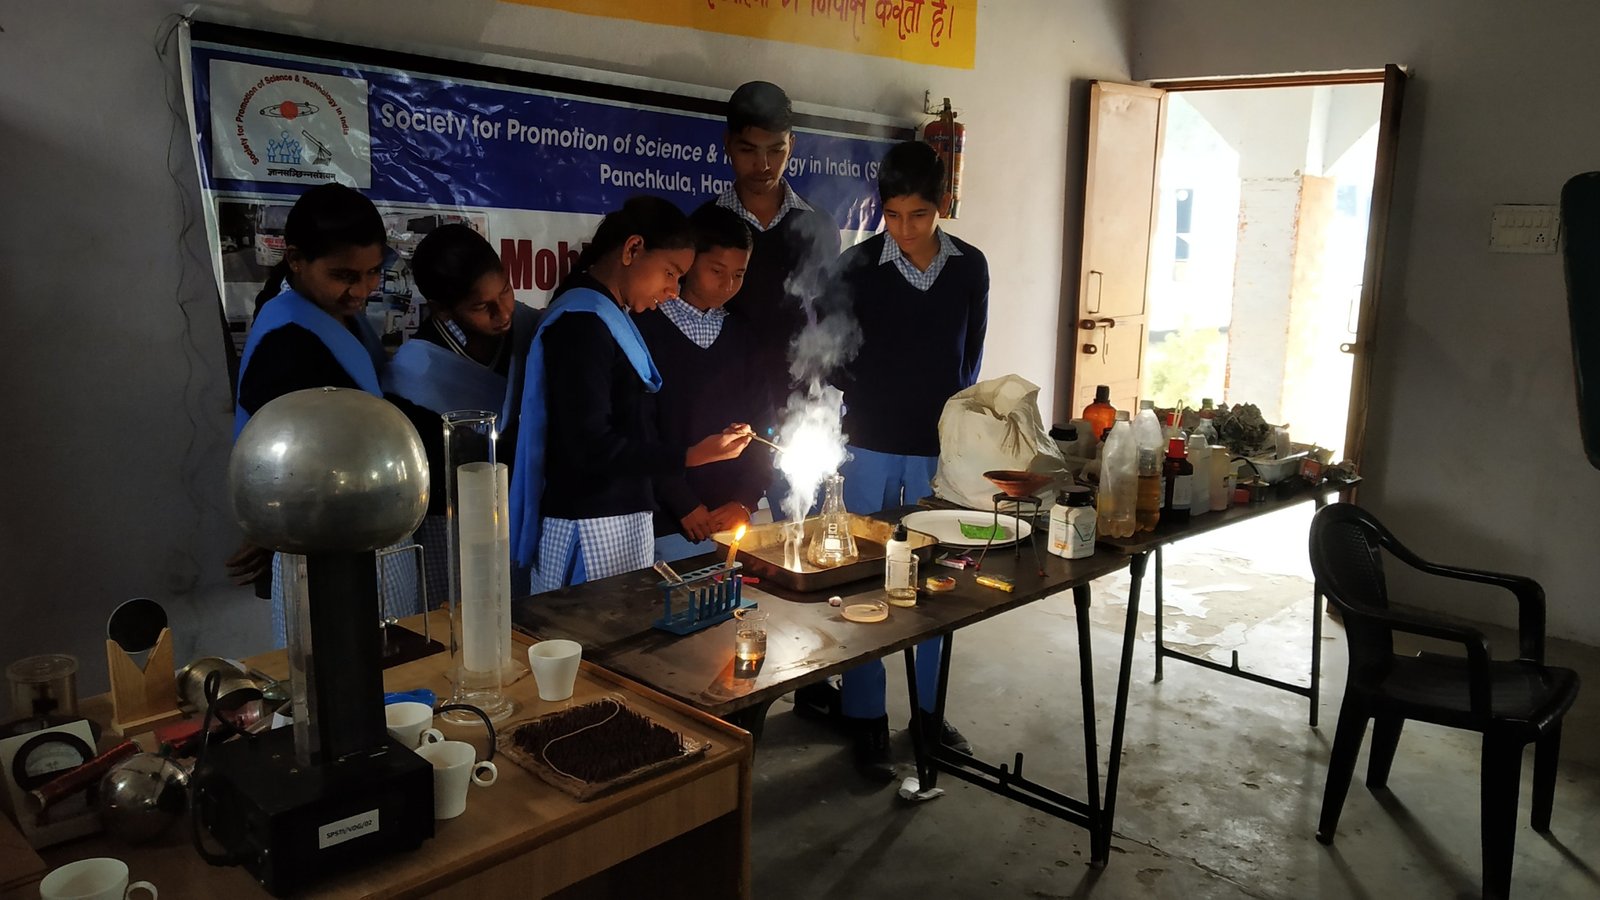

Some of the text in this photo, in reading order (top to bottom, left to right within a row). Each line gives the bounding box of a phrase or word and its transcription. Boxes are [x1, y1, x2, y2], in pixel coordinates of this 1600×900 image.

[257, 79, 265, 89] of
[264, 74, 293, 85] Science
[294, 74, 300, 82] &
[301, 75, 338, 108] Technology
[235, 86, 259, 123] Promotion
[236, 124, 245, 136] for
[381, 102, 467, 141] Society
[472, 114, 502, 140] for
[507, 118, 608, 152] Promotion
[613, 133, 632, 154] of
[635, 134, 703, 162] Science
[706, 143, 718, 163] &
[809, 155, 821, 174] in
[826, 157, 860, 177] India
[240, 137, 260, 166] Society
[600, 163, 697, 197] Panchkula,
